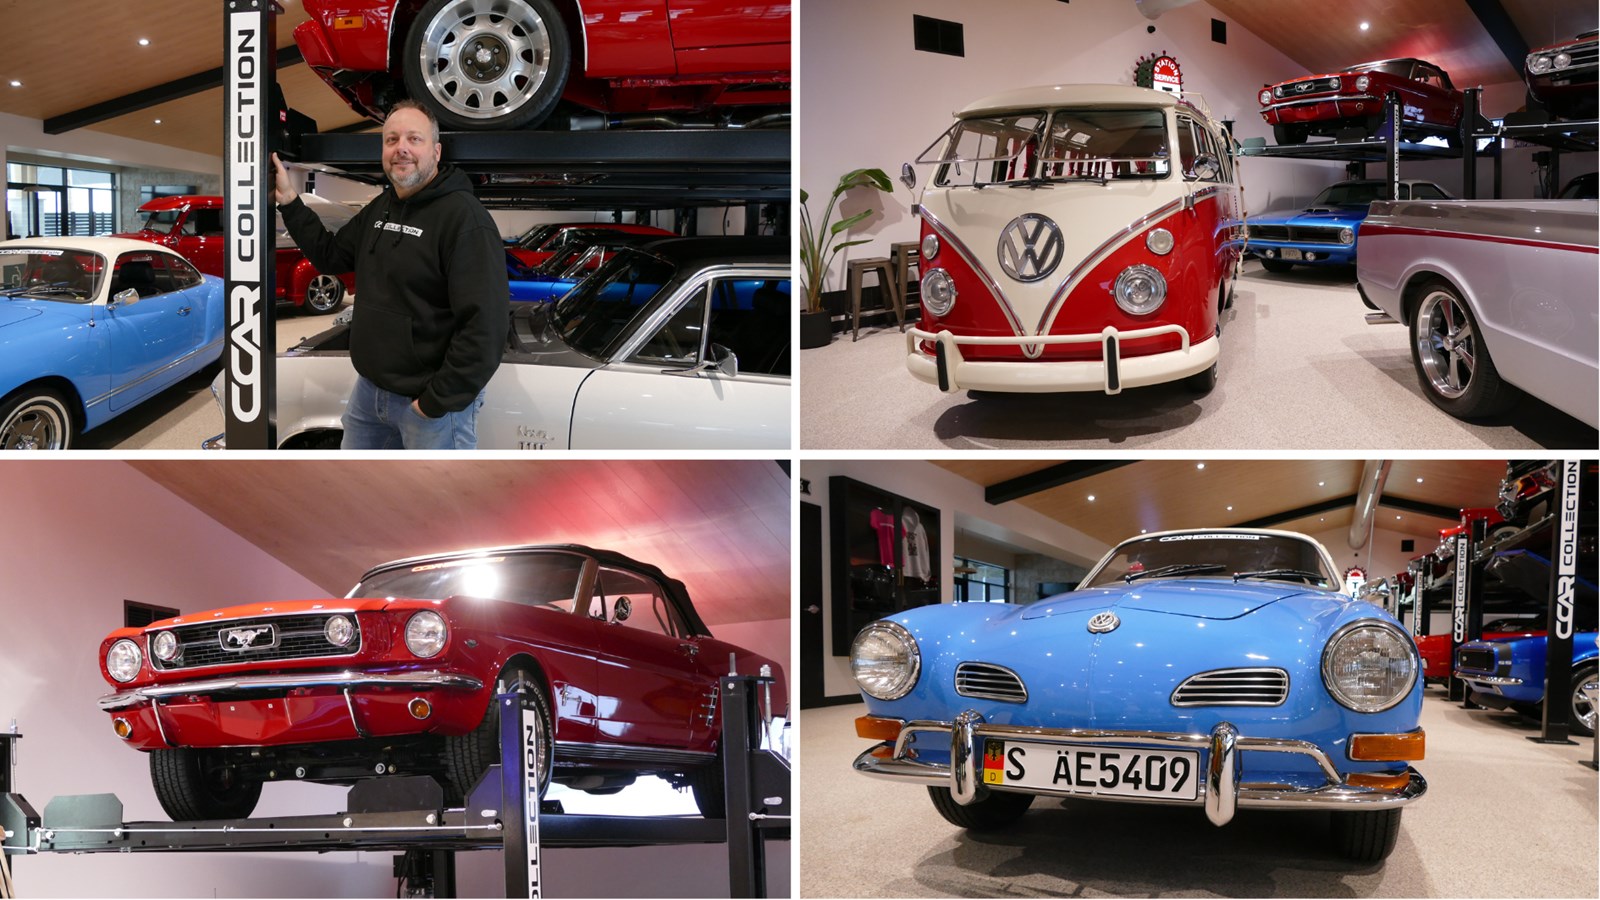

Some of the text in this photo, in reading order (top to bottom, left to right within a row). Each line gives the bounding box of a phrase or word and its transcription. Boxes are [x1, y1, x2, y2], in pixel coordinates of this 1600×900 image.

[1154, 60, 1179, 76] STATION
[1154, 74, 1179, 84] SERVICE
[238, 29, 255, 262] COLLECTION
[997, 213, 1064, 282] VW
[1564, 462, 1577, 566] COLLECTION
[1457, 543, 1466, 602] COLLECTION
[990, 772, 997, 782] D
[1006, 747, 1191, 793] S ÄE5409
